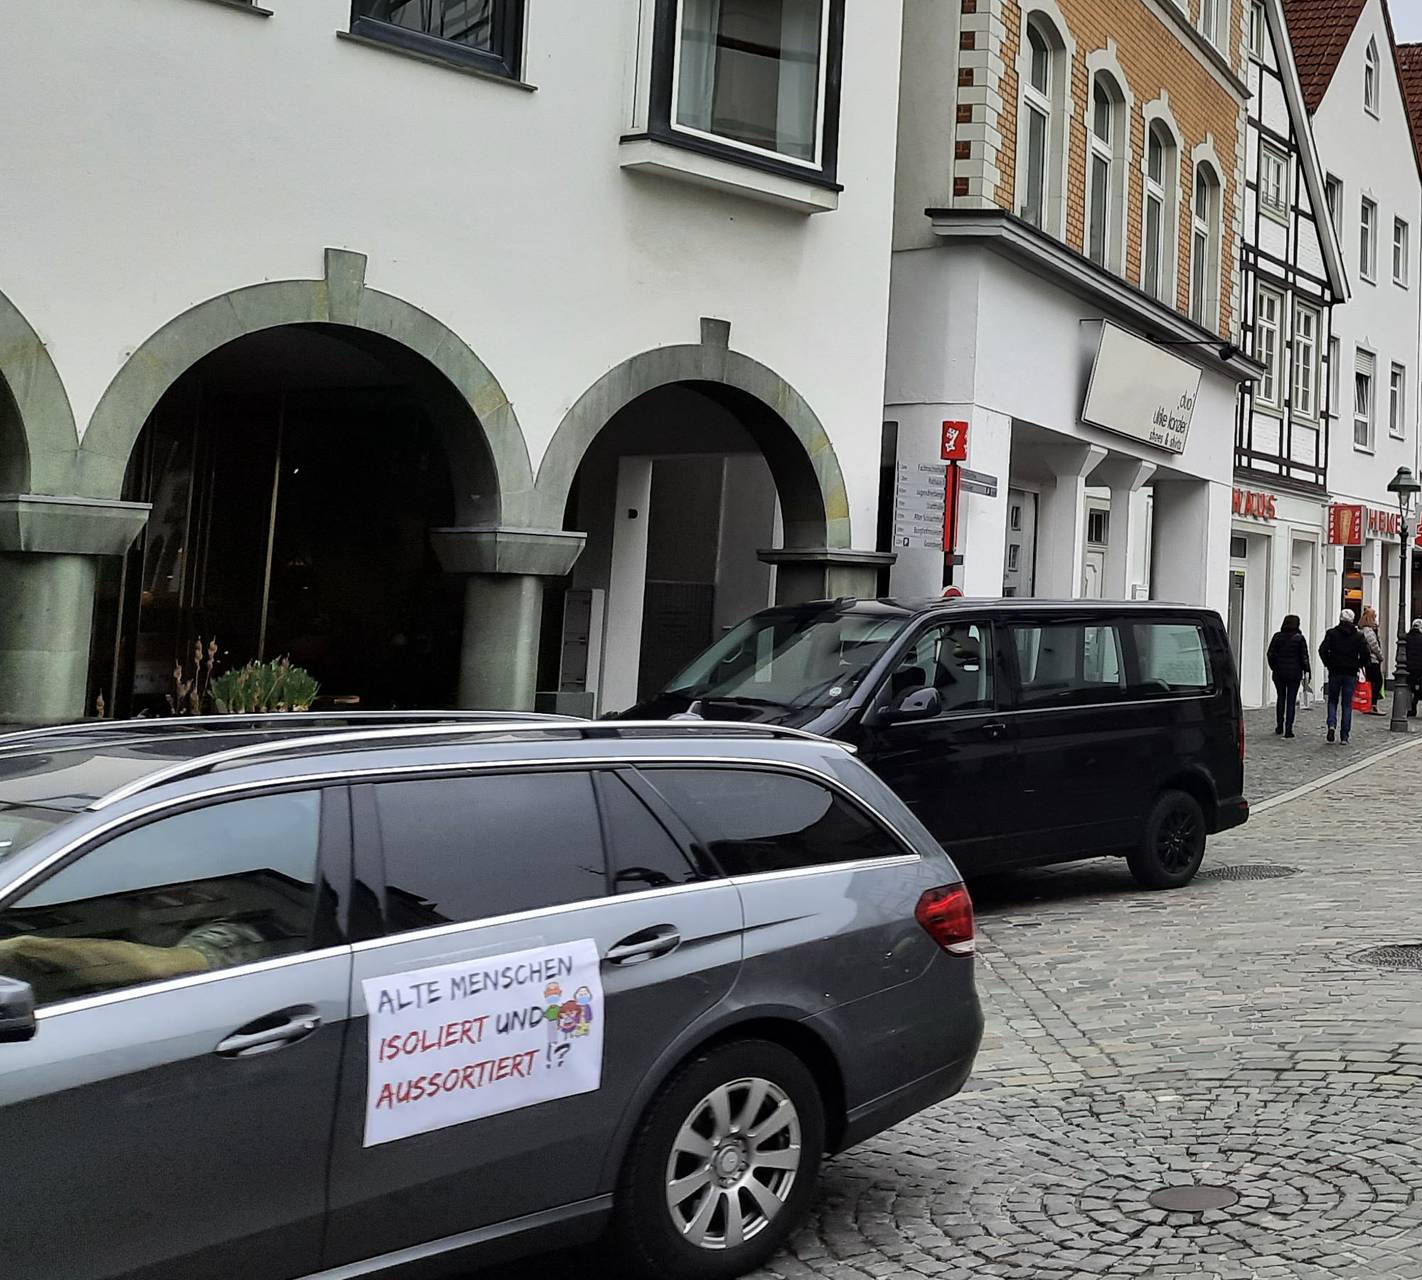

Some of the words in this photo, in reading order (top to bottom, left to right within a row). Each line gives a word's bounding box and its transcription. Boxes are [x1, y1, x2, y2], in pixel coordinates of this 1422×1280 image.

[377, 980, 442, 1016] ALTE
[450, 955, 573, 1001] MENSCHEN
[378, 1015, 490, 1063] ISOLIERT
[495, 1006, 544, 1035] UND
[375, 1049, 541, 1110] AUSSORTIERT
